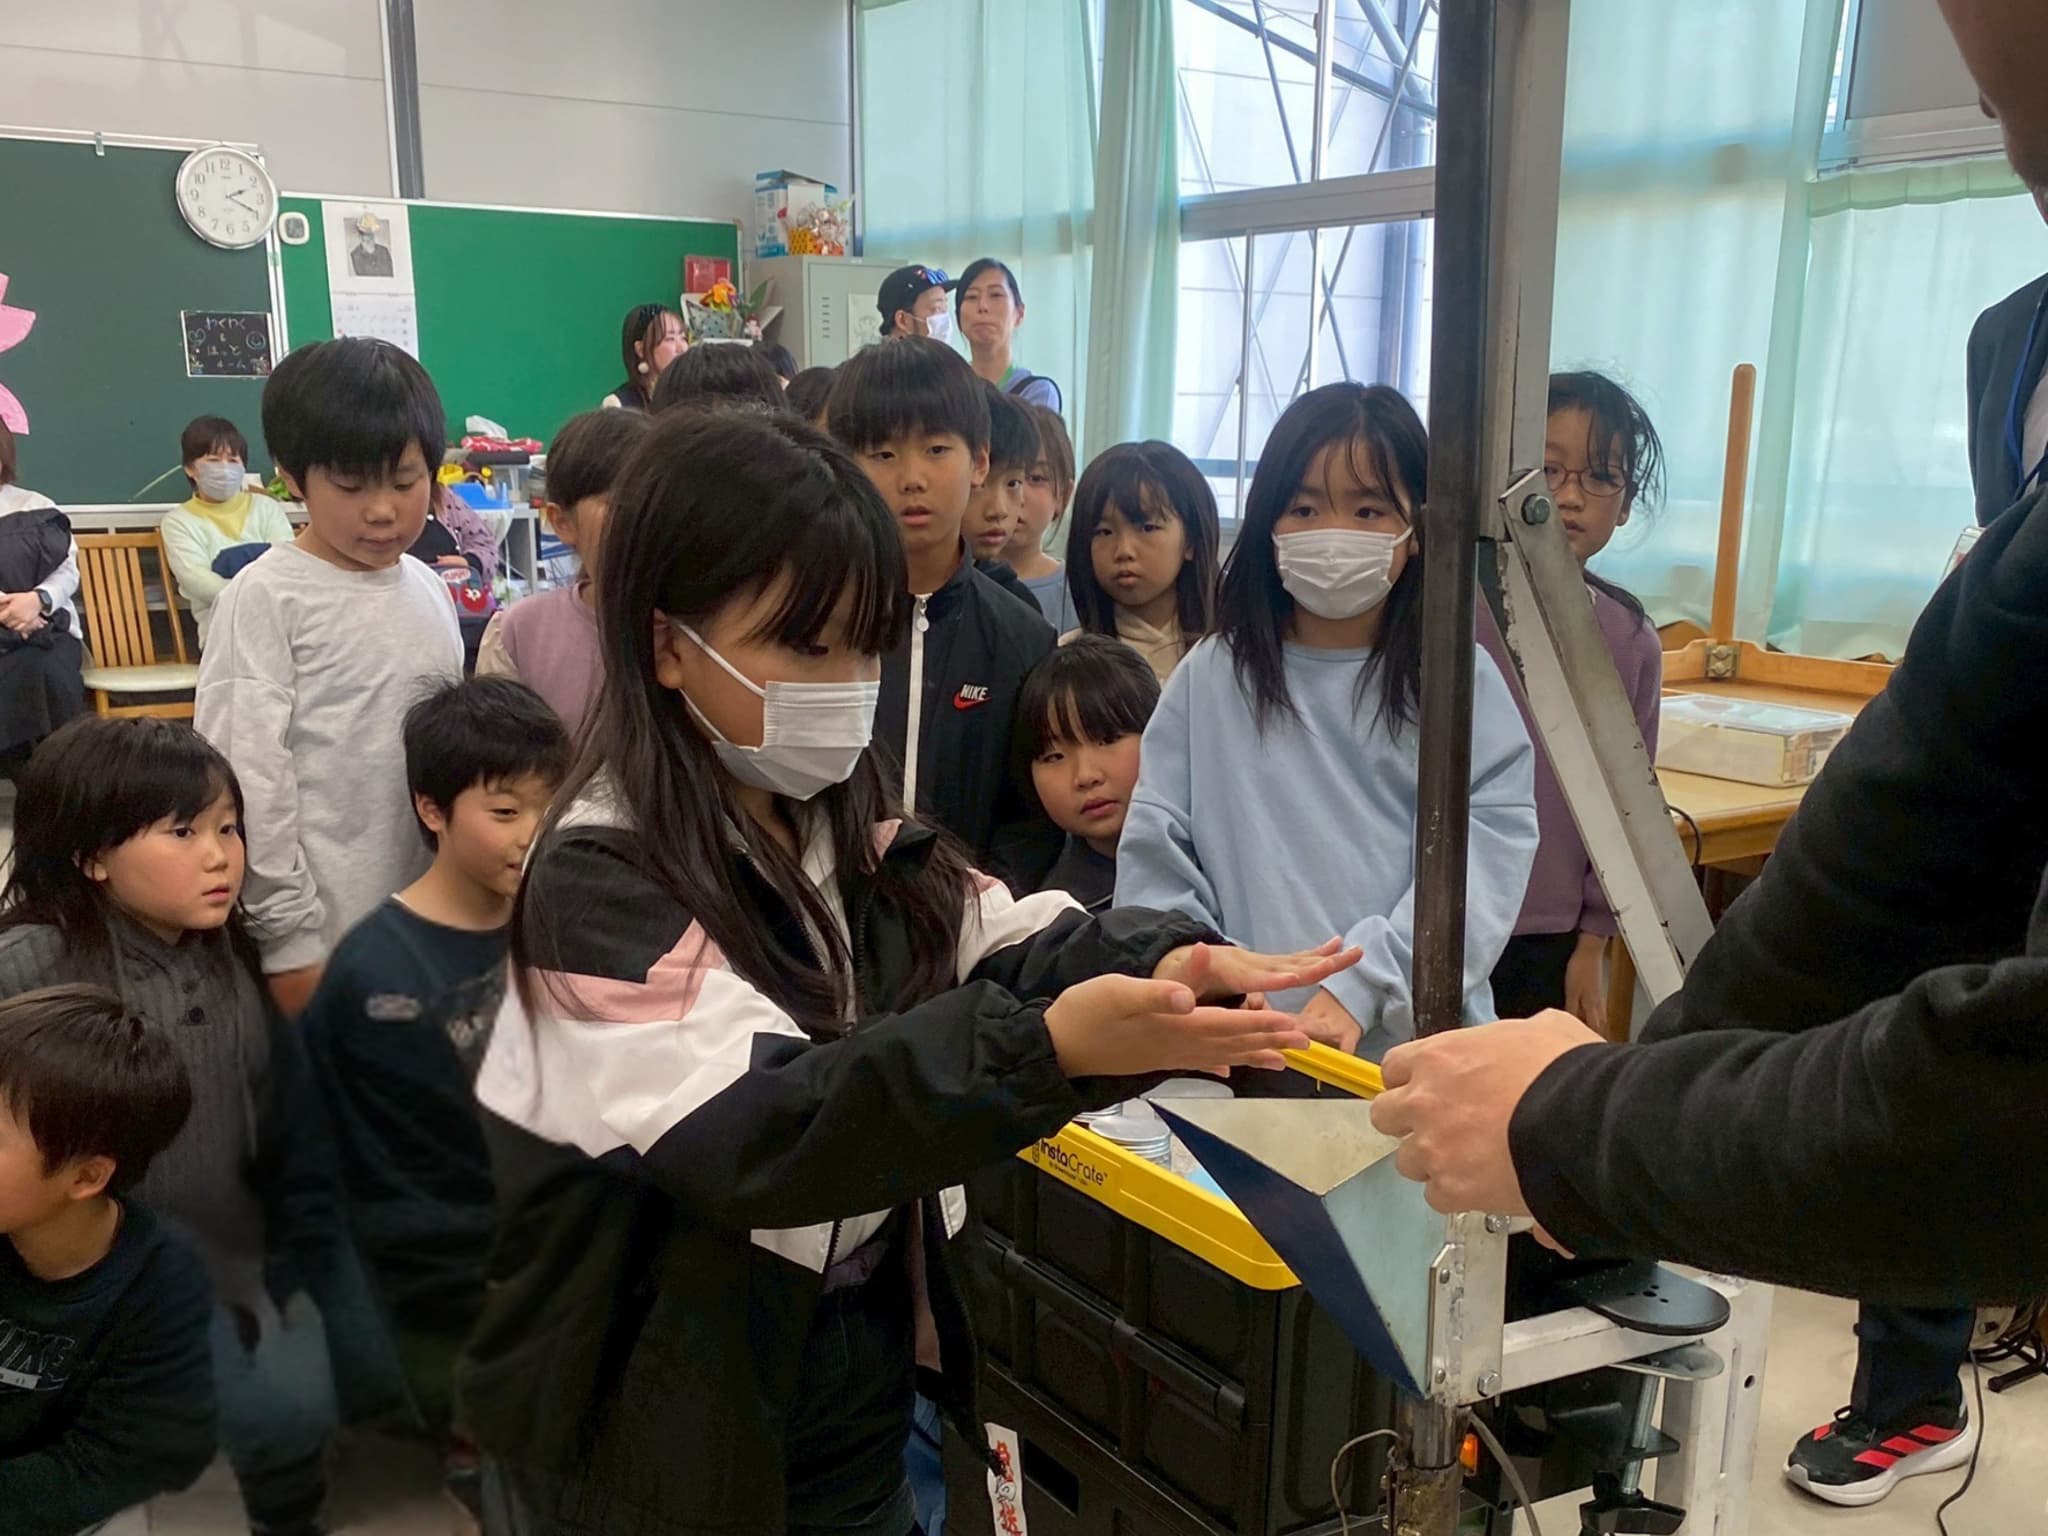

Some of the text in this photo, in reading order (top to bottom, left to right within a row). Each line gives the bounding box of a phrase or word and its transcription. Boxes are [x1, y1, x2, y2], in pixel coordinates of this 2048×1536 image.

[204, 160, 215, 174] 11
[218, 159, 231, 170] 12
[194, 173, 206, 185] 10
[249, 175, 257, 188] 2
[190, 188, 199, 201] 9
[256, 192, 265, 205] 3
[197, 206, 206, 218] 8
[211, 218, 218, 231] 7
[225, 223, 235, 236] 6
[242, 220, 250, 233] 5
[960, 684, 988, 700] NIKE
